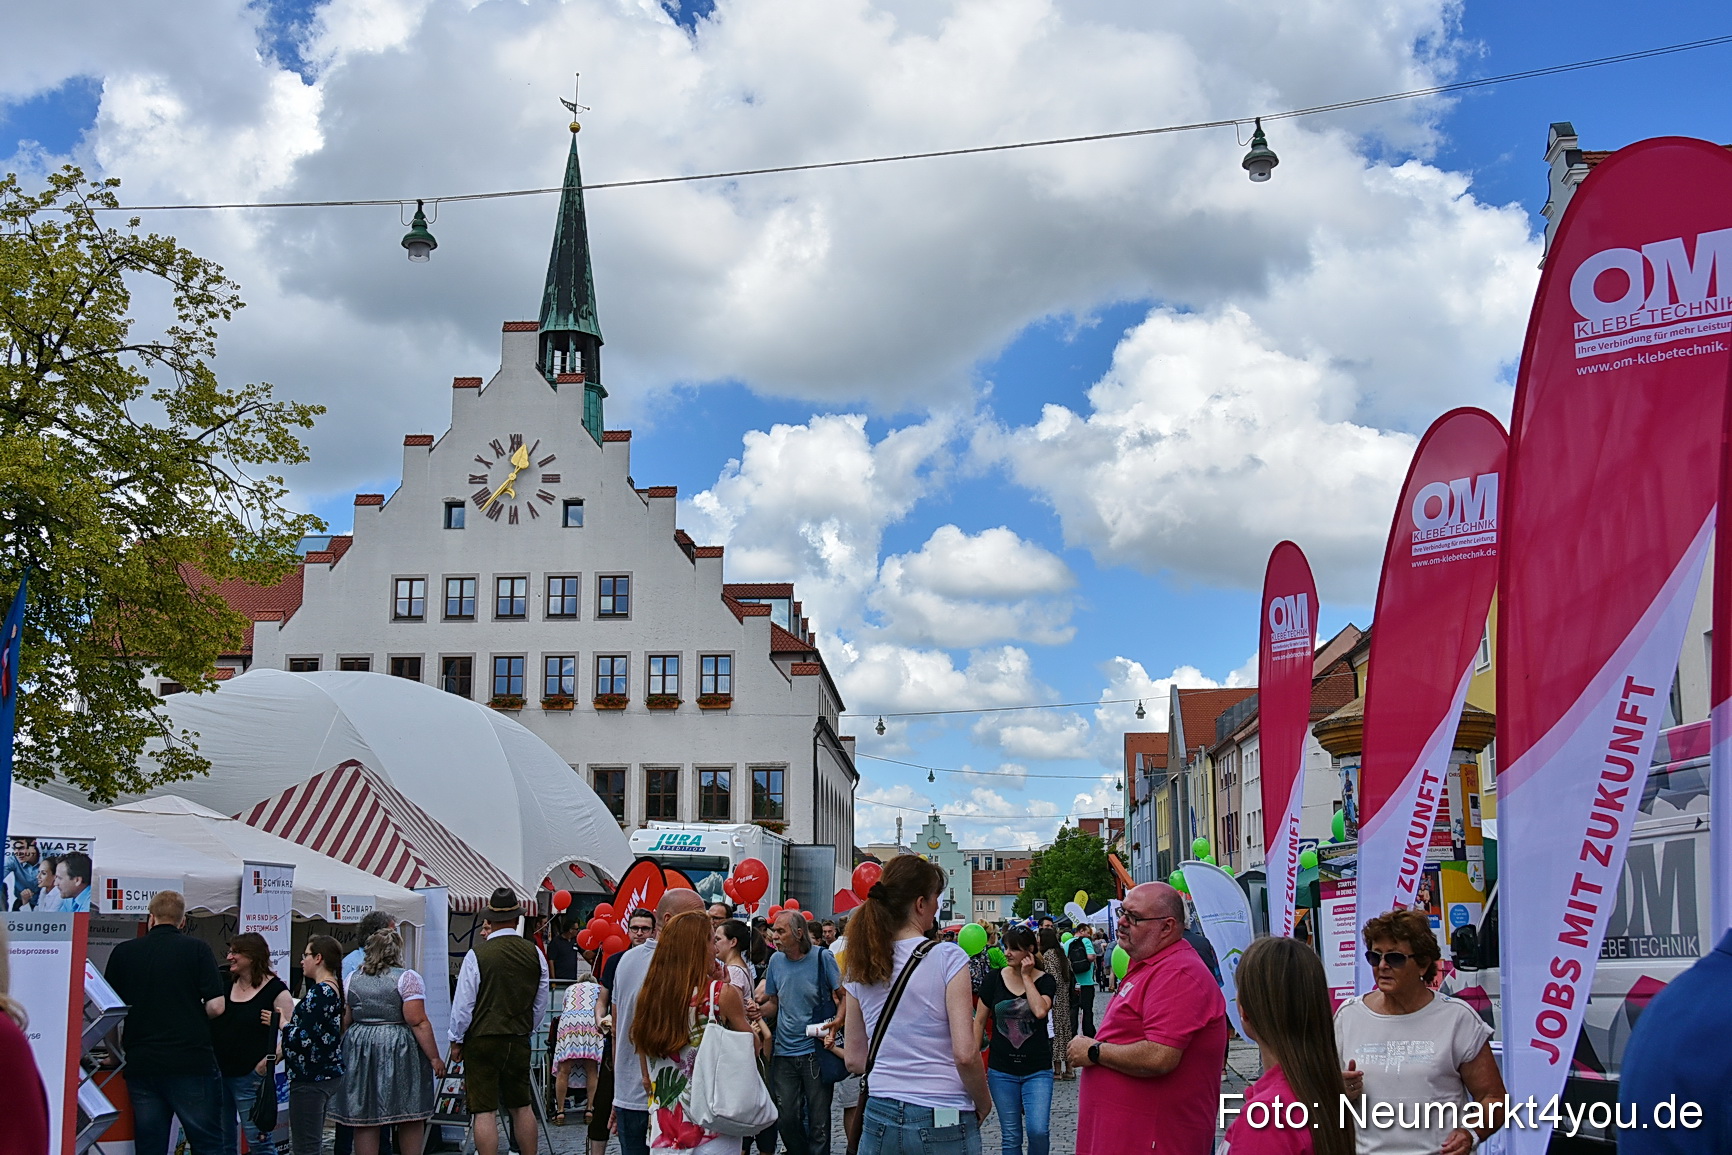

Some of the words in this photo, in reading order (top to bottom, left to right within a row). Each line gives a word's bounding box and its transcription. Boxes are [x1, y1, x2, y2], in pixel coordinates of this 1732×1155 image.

[1570, 228, 1732, 318] OM
[1577, 312, 1641, 337] KLEBE
[1578, 345, 1597, 355] Ihre
[1598, 334, 1653, 350] Verbindung
[1654, 331, 1669, 341] für
[1669, 326, 1696, 338] mehr
[1697, 320, 1732, 333] Leistun
[1412, 472, 1499, 526] OM
[1413, 527, 1446, 542] KLEBE
[1449, 519, 1496, 534] TECHNIK
[1422, 541, 1451, 553] Verbindung
[1458, 538, 1474, 546] mehr
[1269, 593, 1308, 631] OM
[1271, 631, 1287, 641] KLEBE
[1579, 675, 1656, 868] ZUKUNFT
[648, 834, 703, 851] JURA
[1396, 769, 1439, 894] ZUKUNFT
[1286, 813, 1300, 903] ZUKUNFT
[125, 890, 156, 901] SCHW
[263, 880, 293, 888] SCHWARZ
[342, 904, 373, 913] SCHWARZ
[1558, 872, 1603, 949] MIT
[8, 920, 67, 934] ösungen
[9, 947, 59, 956] iebsprozesse
[1600, 938, 1627, 958] EBE
[1629, 936, 1699, 957] TECHNIK
[1530, 955, 1582, 1066] JOBS
[1386, 1041, 1435, 1056] NEVER
